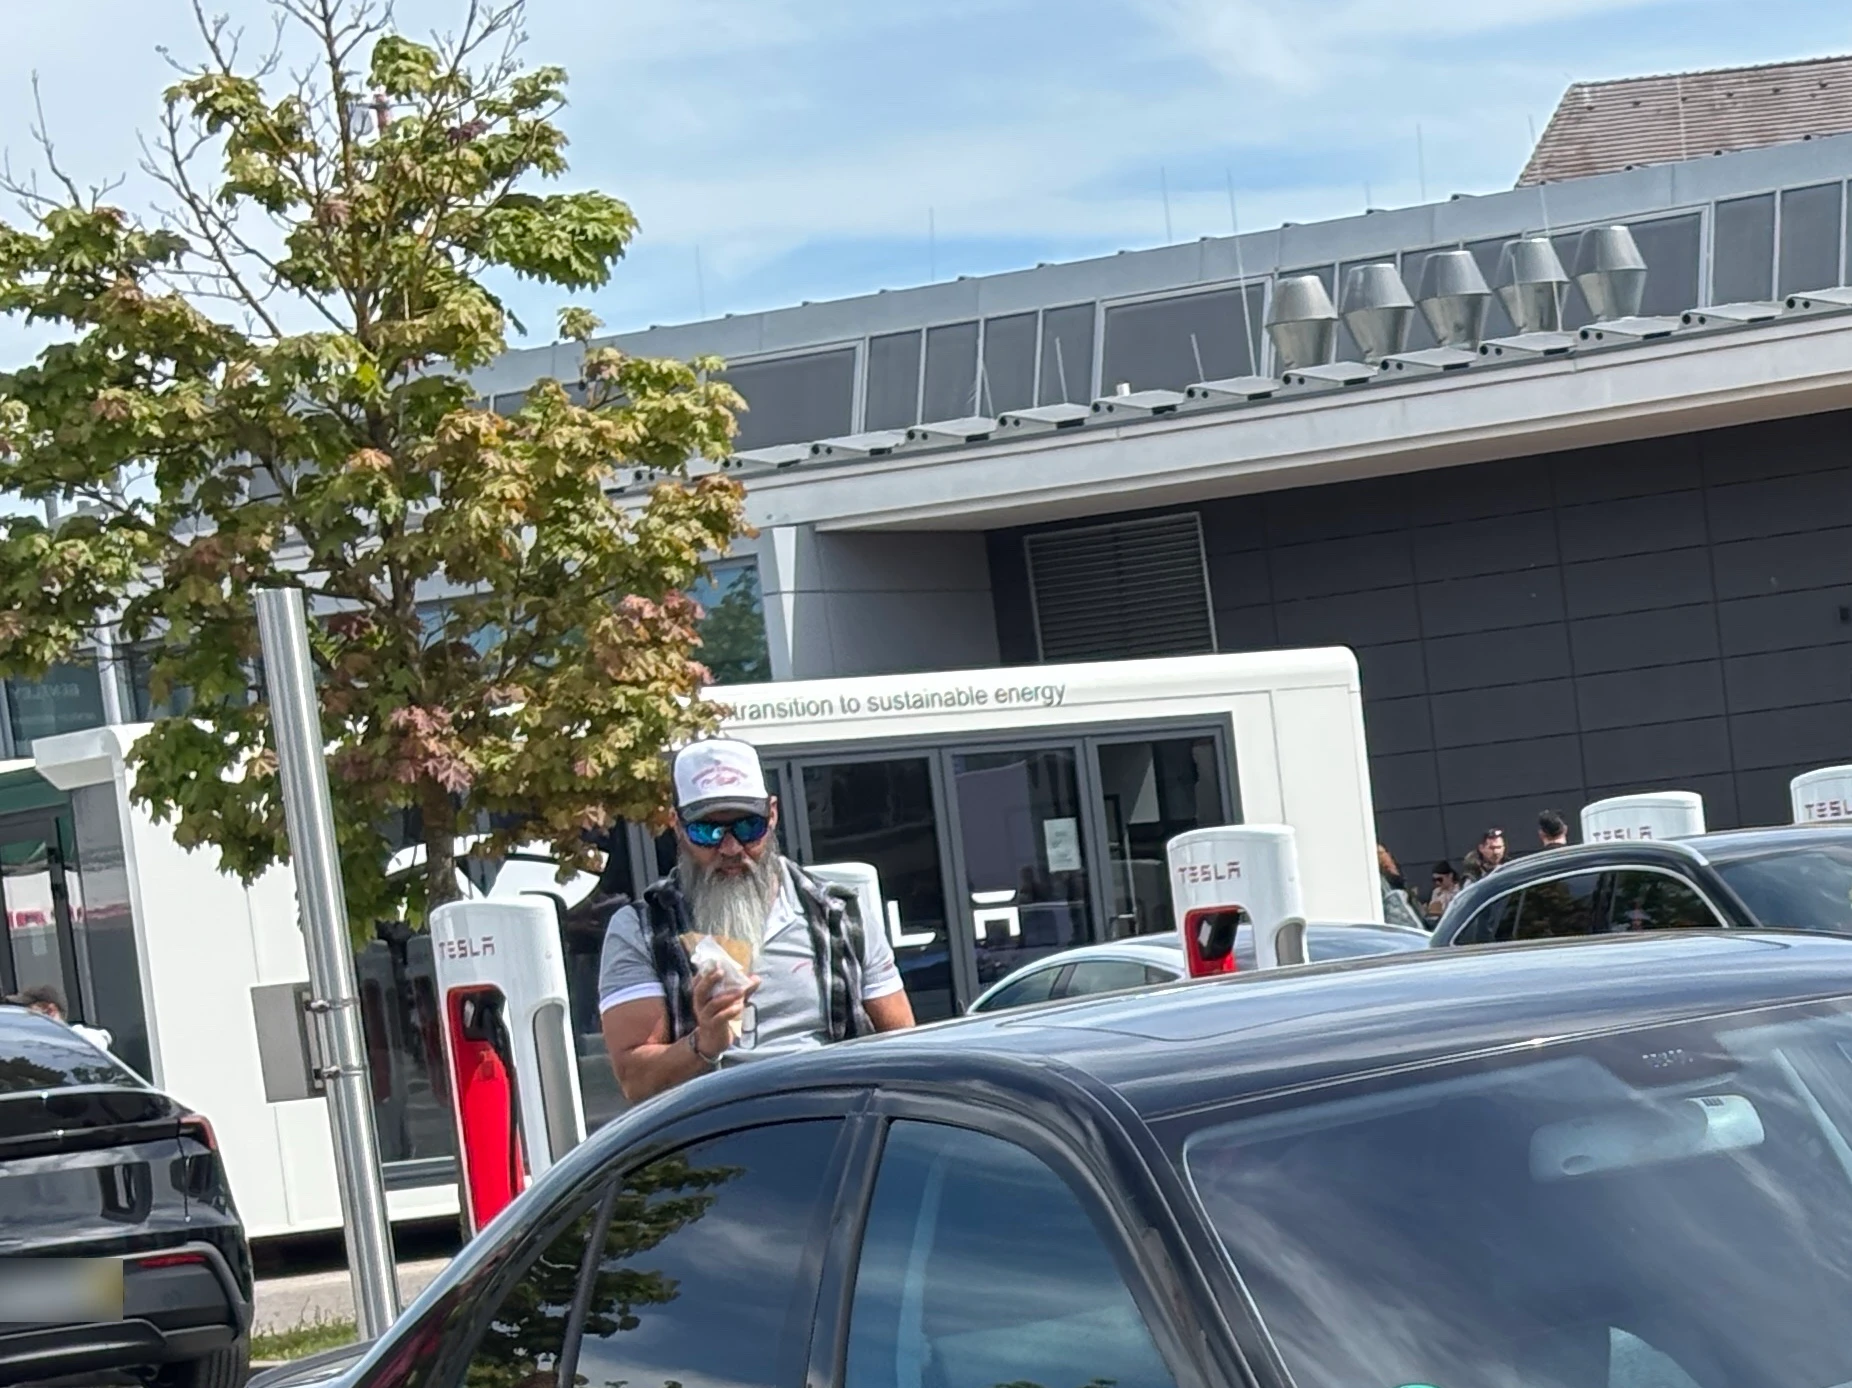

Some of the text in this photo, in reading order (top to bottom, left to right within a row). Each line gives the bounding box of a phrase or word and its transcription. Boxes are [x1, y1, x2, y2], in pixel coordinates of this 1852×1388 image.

[732, 684, 1066, 721] transition to sustainable energy
[1178, 861, 1241, 884] TESLA
[438, 935, 496, 960] TESLA
